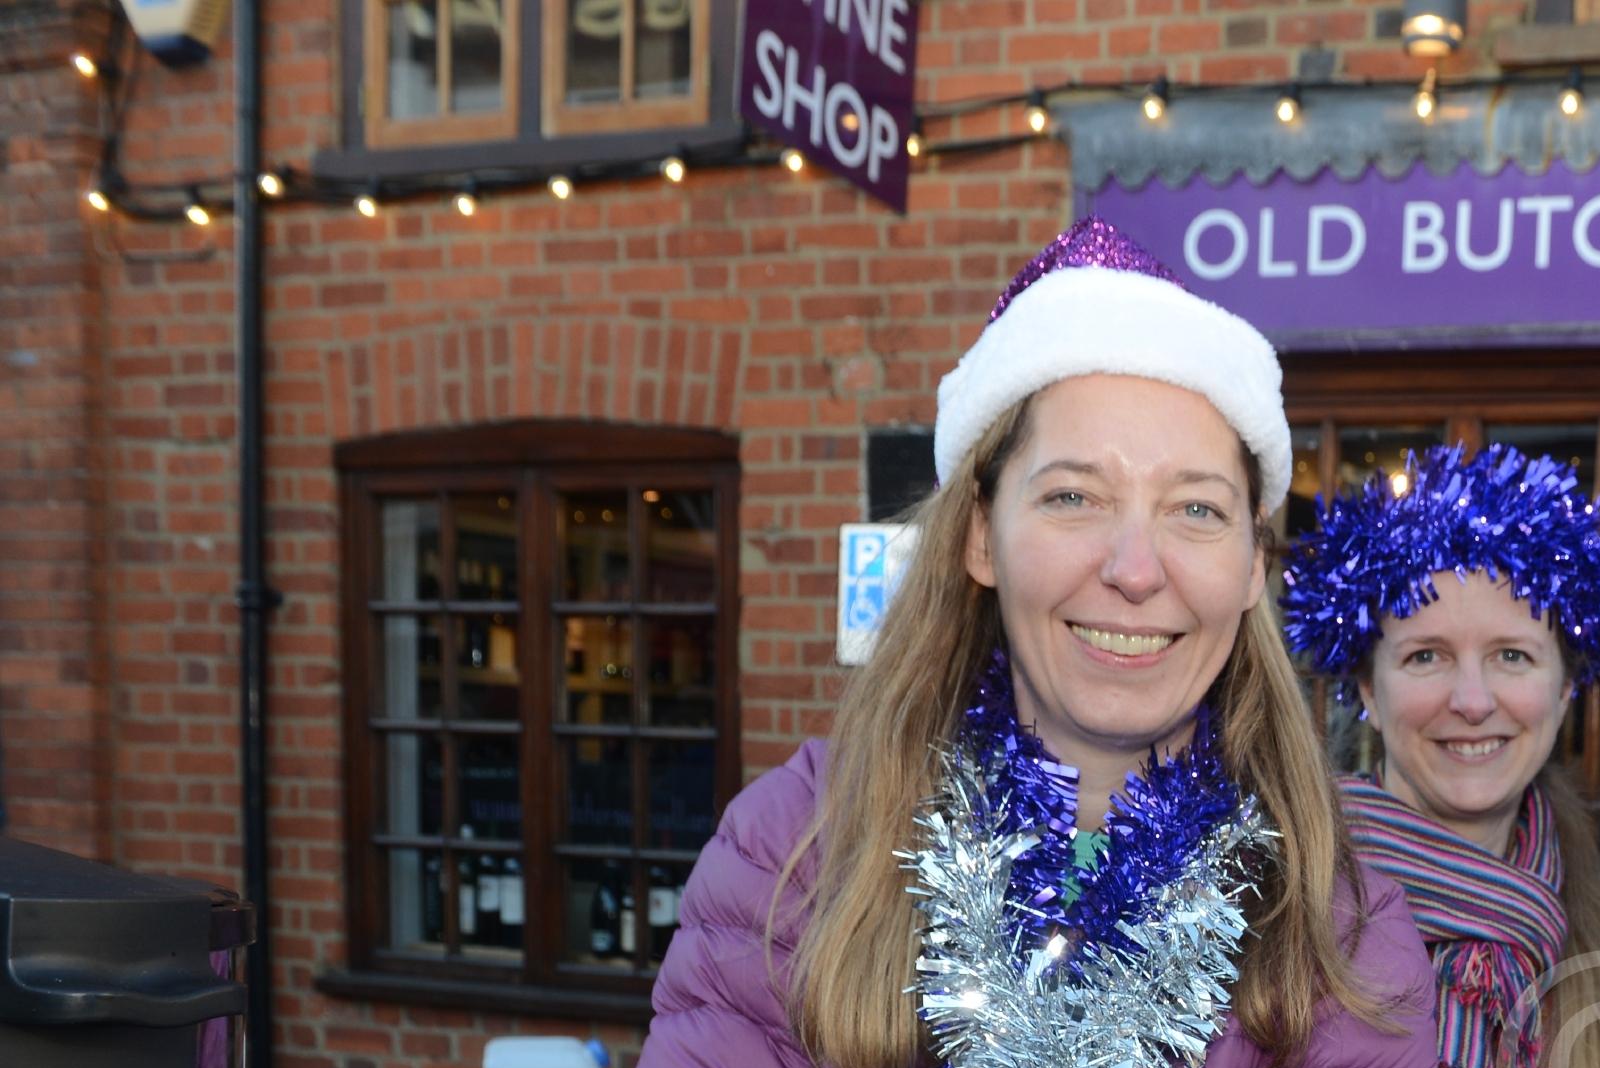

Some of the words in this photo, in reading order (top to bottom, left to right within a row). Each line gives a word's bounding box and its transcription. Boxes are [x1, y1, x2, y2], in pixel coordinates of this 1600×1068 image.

[804, 0, 908, 76] NE
[753, 29, 899, 184] SHOP
[1183, 205, 1367, 281] OLD
